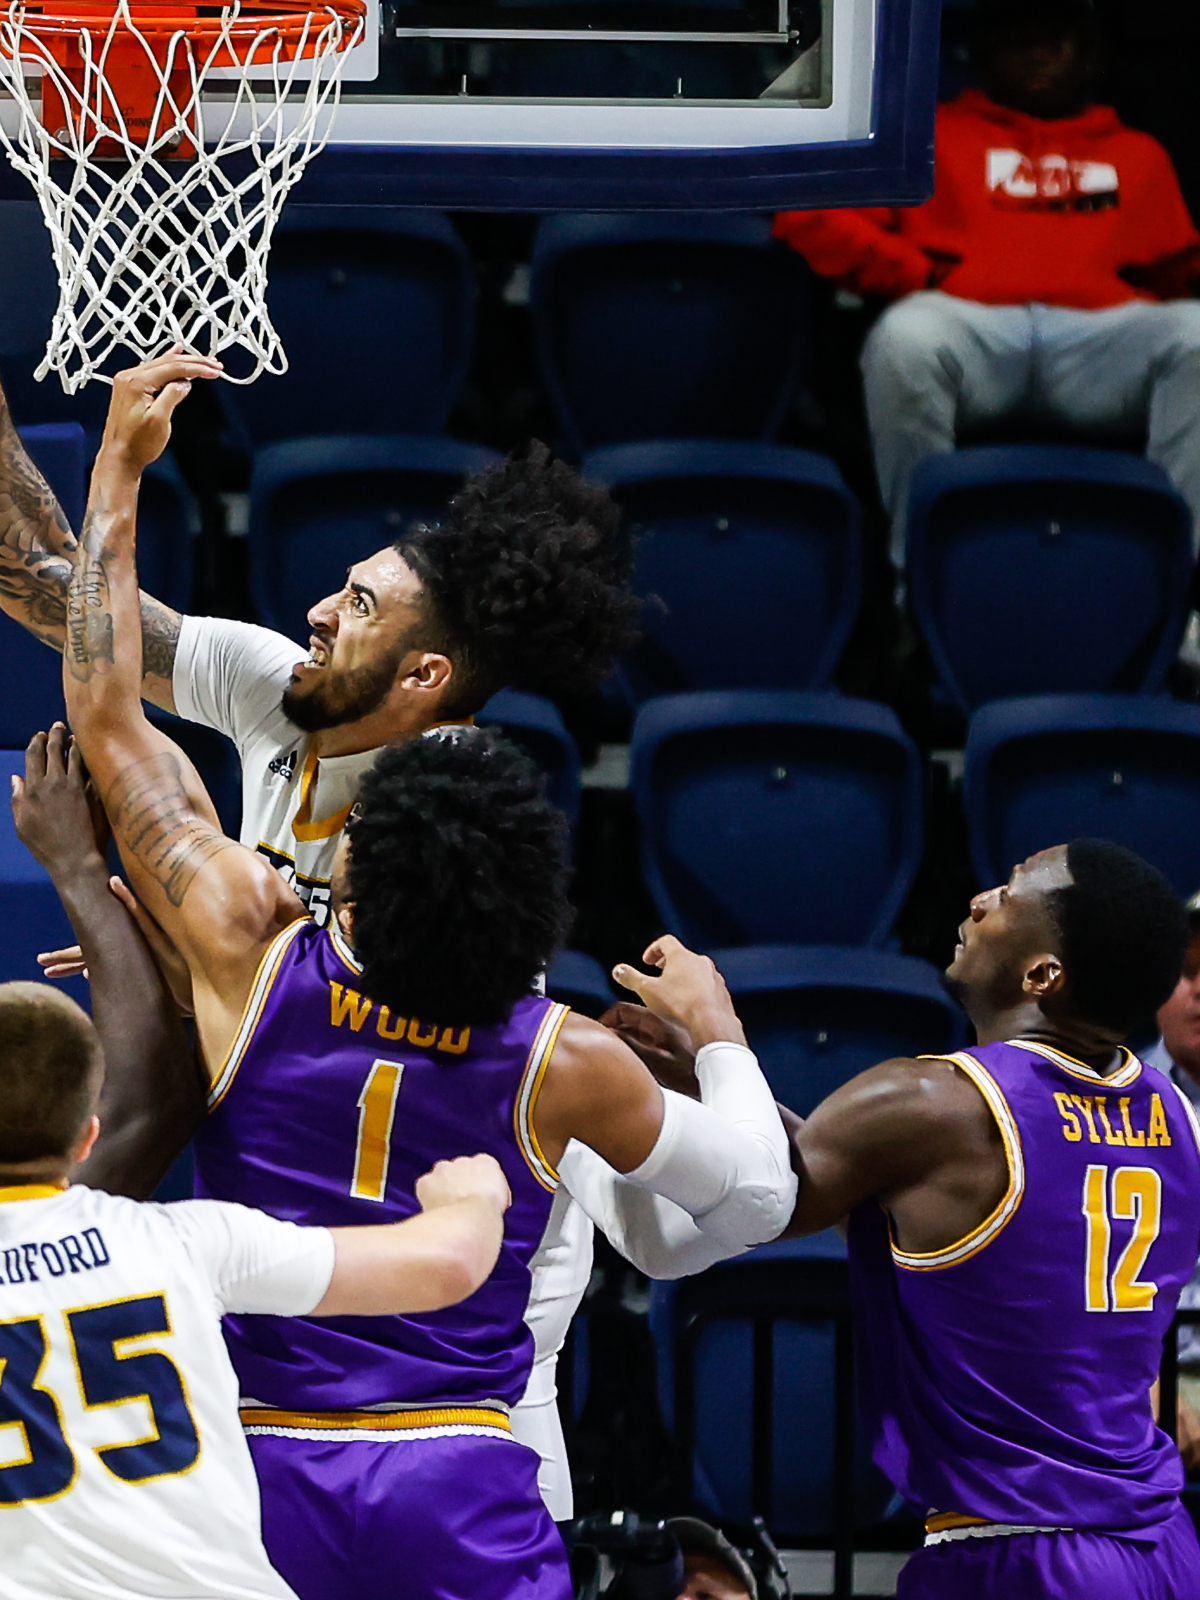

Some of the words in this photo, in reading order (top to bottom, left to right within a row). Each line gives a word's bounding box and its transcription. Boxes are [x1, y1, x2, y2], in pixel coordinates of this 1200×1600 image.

[350, 1058, 405, 1203] 1
[1053, 1092, 1172, 1147] SYLLA
[1082, 1164, 1162, 1312] 12
